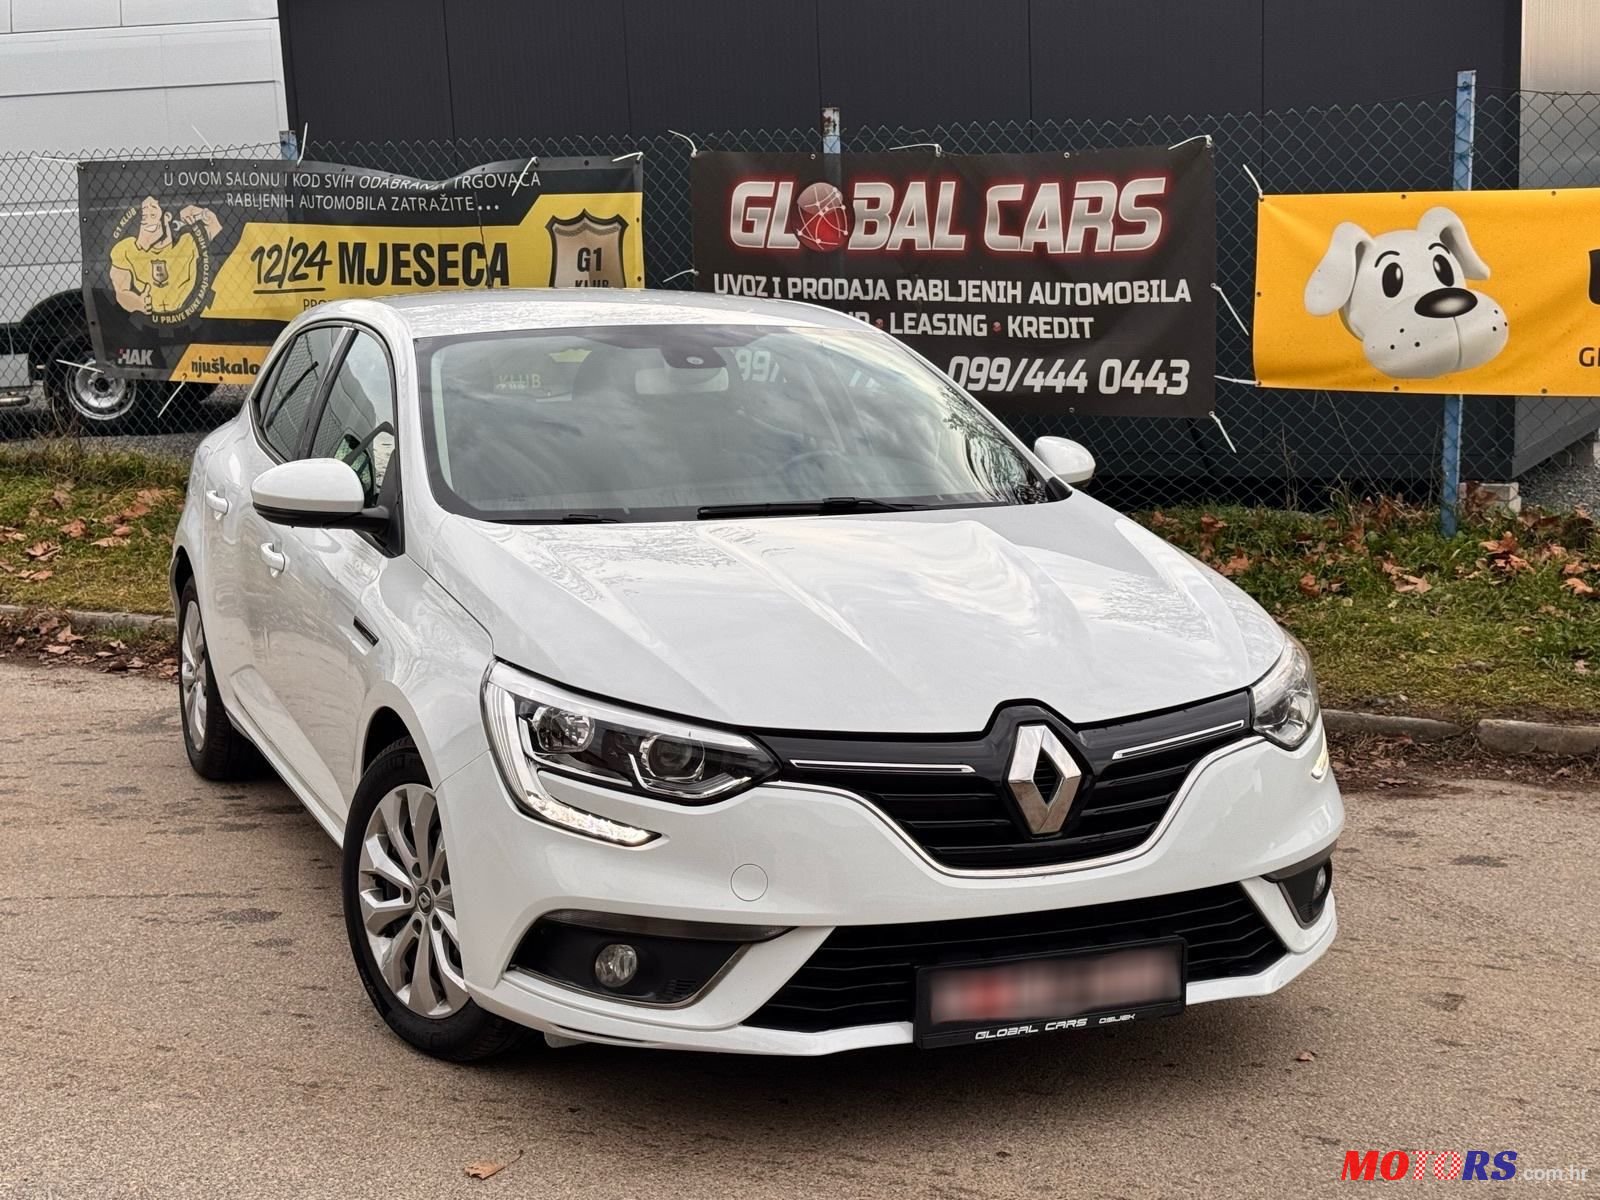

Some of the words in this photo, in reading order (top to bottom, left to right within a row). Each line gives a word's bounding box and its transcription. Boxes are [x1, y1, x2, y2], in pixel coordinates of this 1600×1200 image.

[164, 172, 174, 187] U
[178, 171, 222, 187] OVOM
[226, 172, 280, 188] SALONU
[284, 172, 288, 188] I
[293, 173, 321, 189] KOD
[324, 174, 354, 190] SVIH
[226, 193, 294, 210] RABLJENIH
[300, 194, 385, 211] AUTOMOBILA
[730, 181, 966, 251] GLOBAL
[984, 177, 1166, 254] CARS
[250, 236, 333, 290] 12/24
[338, 242, 510, 287] MJESECA
[577, 247, 602, 272] G1
[713, 273, 767, 297] UVOZ
[773, 277, 781, 299] I
[787, 277, 890, 301] PRODAJA
[896, 278, 1022, 304] RABLJENIH
[1028, 279, 1192, 305] AUTOMOBILA
[890, 311, 987, 336] LEASING
[1007, 315, 1094, 339] KREDIT
[191, 356, 260, 378] njuškalo
[948, 355, 1088, 394] 099/444
[1098, 358, 1191, 395] 0443
[975, 1025, 1039, 1040] GLOBAL
[1045, 1018, 1089, 1031] CARS
